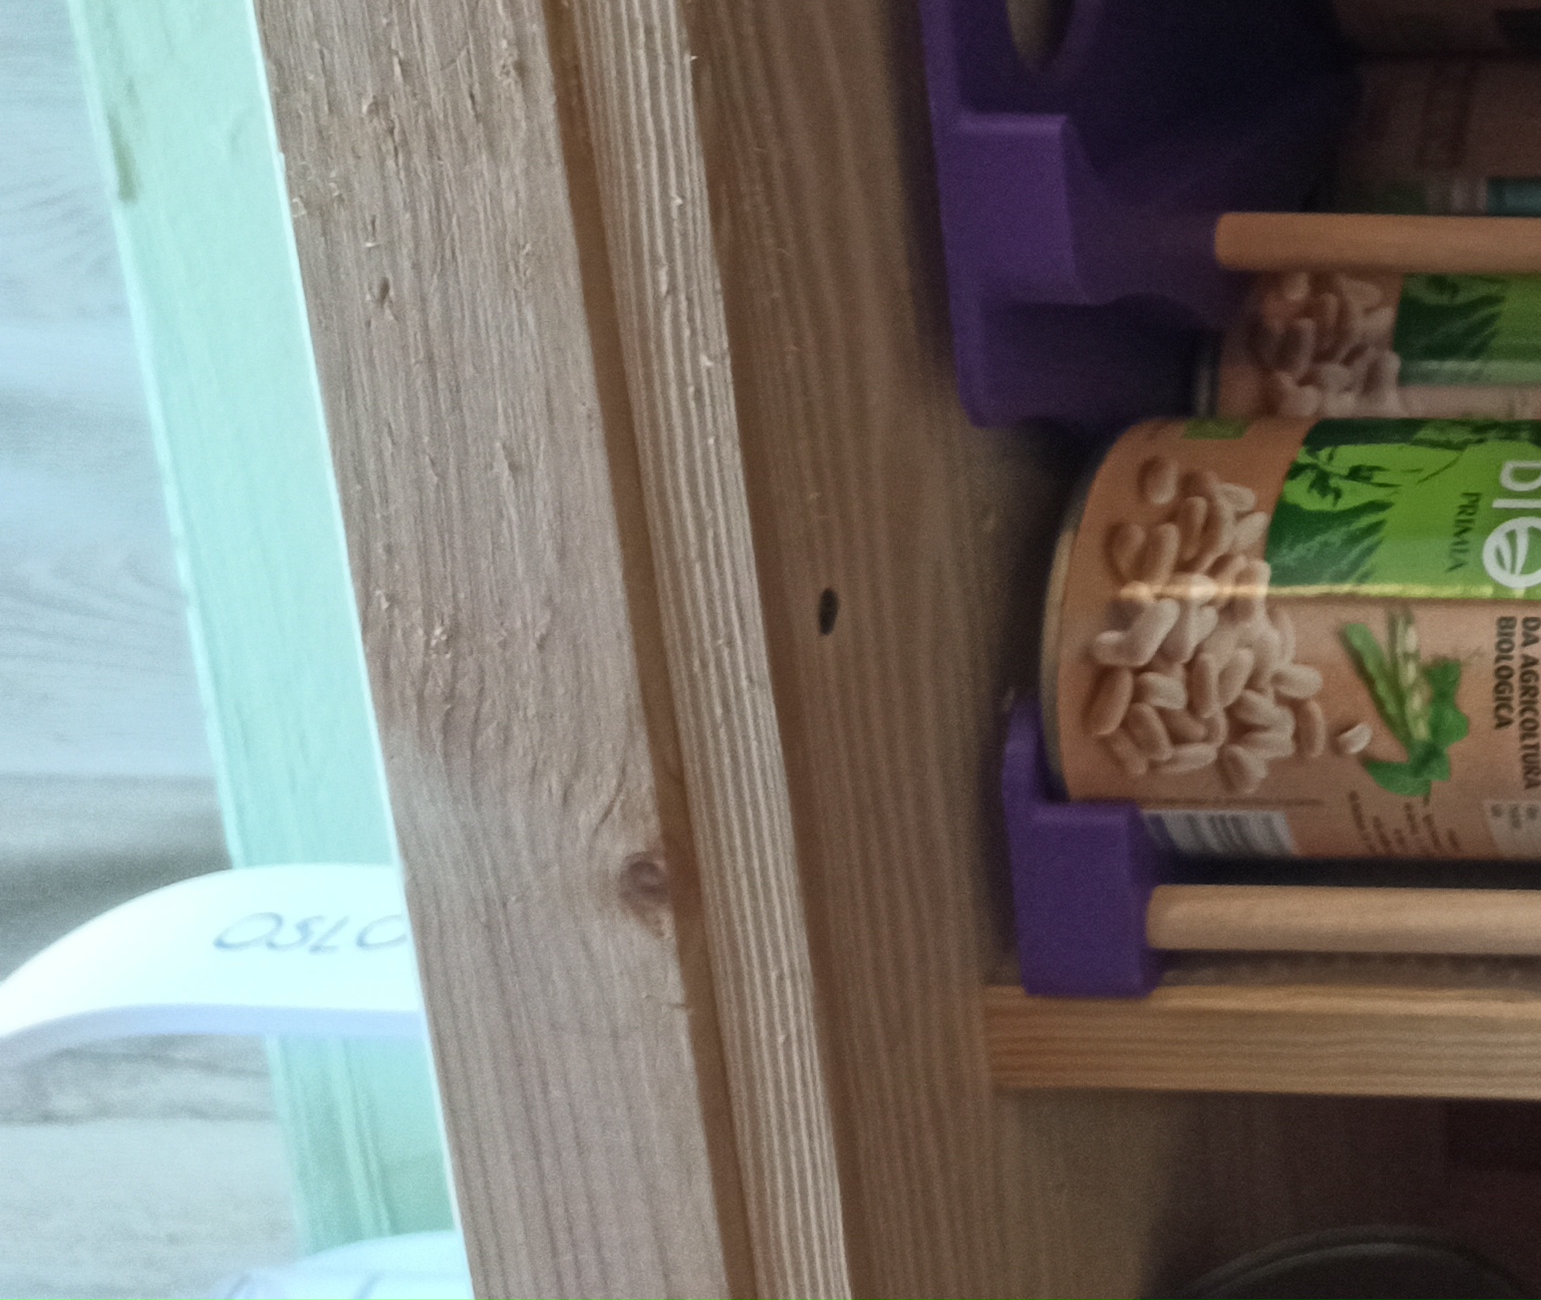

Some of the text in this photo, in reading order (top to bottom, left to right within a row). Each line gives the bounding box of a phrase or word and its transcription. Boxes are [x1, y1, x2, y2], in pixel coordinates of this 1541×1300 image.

[1445, 493, 1483, 573] PRIMIA
[1521, 616, 1541, 647] DA
[1494, 616, 1517, 730] BIOLOGICA
